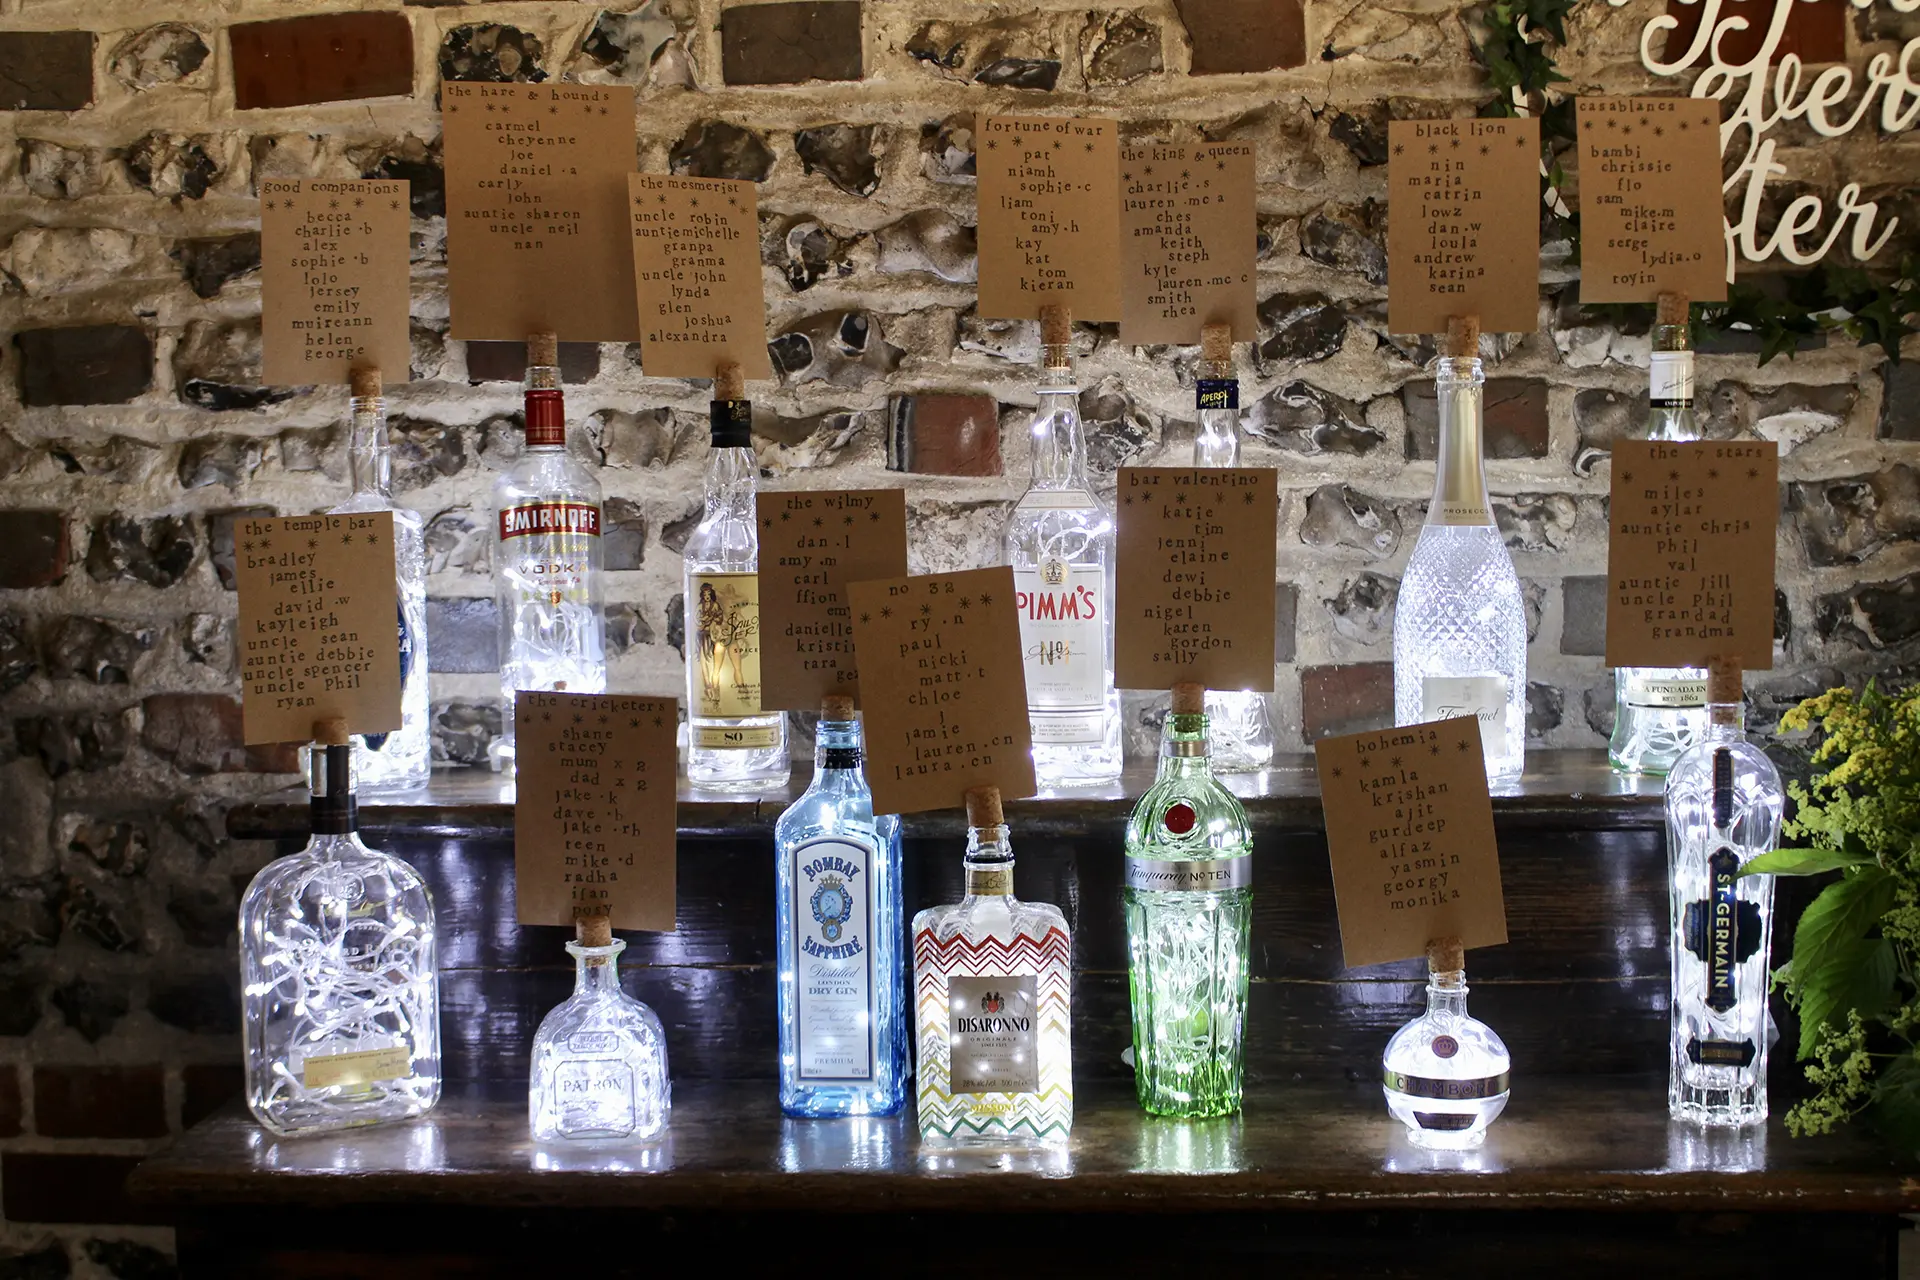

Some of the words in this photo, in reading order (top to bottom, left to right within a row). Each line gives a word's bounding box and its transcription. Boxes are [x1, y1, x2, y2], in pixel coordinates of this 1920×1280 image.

[448, 86, 472, 97] the
[480, 86, 516, 97] hare
[527, 91, 539, 100] &
[551, 89, 610, 102] hounds
[1579, 100, 1676, 113] casablanca
[485, 120, 541, 132] carmel
[984, 118, 1051, 134] fortune
[1055, 121, 1071, 134] of
[1074, 125, 1104, 136] war
[1415, 124, 1460, 138] black
[1470, 123, 1507, 137] lion
[498, 134, 577, 147] cheyenne
[510, 150, 534, 161] joe
[1023, 149, 1051, 161] pat
[1121, 146, 1145, 160] the
[1152, 147, 1185, 162] king
[1194, 151, 1205, 162] &
[1208, 145, 1251, 159] queen
[1591, 144, 1641, 158] bambi
[1007, 165, 1056, 178] niamh
[1430, 159, 1465, 172] nin
[1601, 159, 1673, 173] chrissie
[263, 180, 301, 194] good
[311, 182, 400, 196] companions
[478, 178, 523, 190] carly
[640, 177, 664, 190] the
[668, 179, 740, 195] mesmerist
[1408, 175, 1462, 187] maria
[507, 192, 542, 204] john
[1424, 189, 1482, 201] catrin
[1596, 195, 1623, 205] sam
[1000, 195, 1034, 210] liam
[306, 211, 353, 224] becca
[464, 208, 515, 220] auntie
[526, 208, 581, 220] sharon
[634, 209, 676, 222] uncle
[690, 213, 728, 225] robin
[1020, 211, 1055, 221] toni
[490, 223, 533, 235] uncle
[548, 223, 580, 235] neil
[1133, 225, 1192, 237] amanda
[1625, 219, 1676, 233] claire
[302, 239, 339, 252] alex
[514, 240, 543, 250] nan
[663, 242, 714, 255] granpa
[1015, 237, 1042, 252] kay
[1160, 237, 1204, 250] keith
[1608, 238, 1649, 251] serge
[672, 256, 726, 269] granma
[1025, 253, 1052, 265] kat
[1413, 252, 1476, 265] andrew
[642, 268, 684, 281] uncle
[1038, 267, 1067, 279] tom
[1143, 264, 1177, 278] kyle
[1429, 266, 1485, 280] karina
[304, 272, 338, 286] lolo
[1019, 278, 1075, 292] kieran
[309, 286, 361, 299] jersey
[672, 284, 711, 299] lynda
[1429, 282, 1466, 293] sean
[313, 300, 361, 314] emily
[1147, 294, 1192, 306] smith
[659, 301, 692, 315] glen
[291, 316, 373, 330] muireann
[684, 314, 732, 329] joshua
[305, 332, 353, 346] helen
[649, 330, 728, 343] alexandra
[304, 346, 365, 361] george
[1649, 445, 1679, 460] the
[1716, 447, 1764, 459] stars
[1130, 473, 1161, 488] bar
[1172, 471, 1259, 488] valentino
[787, 496, 813, 510] the
[824, 493, 874, 510] wilmy
[1163, 504, 1214, 520] katie
[245, 520, 273, 536] the
[283, 517, 341, 532] temple
[349, 517, 375, 531] bar
[505, 510, 597, 533] SMIRNOFF
[1621, 521, 1682, 536] auntie
[1701, 519, 1751, 535] chris
[247, 552, 316, 569] bradley
[1170, 549, 1229, 565] elaine
[518, 563, 589, 574] VODKA
[270, 568, 317, 587] james
[794, 571, 829, 585] carl
[1619, 576, 1680, 590] auntie
[290, 578, 335, 595] ellie
[889, 584, 909, 597] no
[796, 589, 837, 604] ffion
[1172, 587, 1232, 603] debbie
[1620, 591, 1675, 606] uncle
[1143, 605, 1193, 620] nigel
[1644, 608, 1731, 624] grandad
[256, 612, 340, 634] kayleigh
[1163, 622, 1211, 636] karen
[1652, 625, 1734, 640] grandma
[248, 636, 298, 651] uncle
[321, 631, 360, 645] sean
[900, 633, 942, 657] paul
[1170, 635, 1232, 651] gordon
[247, 650, 305, 667] auntie
[316, 646, 375, 662] debbie
[918, 650, 968, 669] nicki
[1152, 650, 1199, 665] sally
[244, 665, 294, 682] uncle
[304, 661, 371, 679] spencer
[254, 678, 306, 694] uncle
[1651, 685, 1695, 693] FUNDADA
[277, 695, 316, 710] ryan
[528, 694, 557, 708] the
[571, 697, 666, 713] cricketers
[908, 689, 961, 706] chloe
[563, 727, 613, 740] shane
[724, 732, 743, 742] 80
[905, 723, 960, 747] jamie
[548, 741, 608, 756] stacey
[1356, 729, 1438, 754] bohemia
[560, 757, 598, 768] mum
[570, 773, 600, 786] dad
[1359, 769, 1419, 793] kamla
[1372, 781, 1449, 808] krishan
[1368, 818, 1446, 844] gurdeep
[802, 856, 861, 882] BOMBAY
[1390, 853, 1460, 879] yasmin
[564, 870, 618, 883] radha
[1130, 864, 1187, 884] Tanqueray
[1209, 869, 1232, 881] TEN
[572, 904, 613, 918] posy
[801, 935, 863, 960] SAPPHIRE
[808, 963, 861, 978] Distilled
[808, 987, 833, 995] DRY
[835, 987, 858, 995] GIN
[958, 1017, 1030, 1033] DISARONNO
